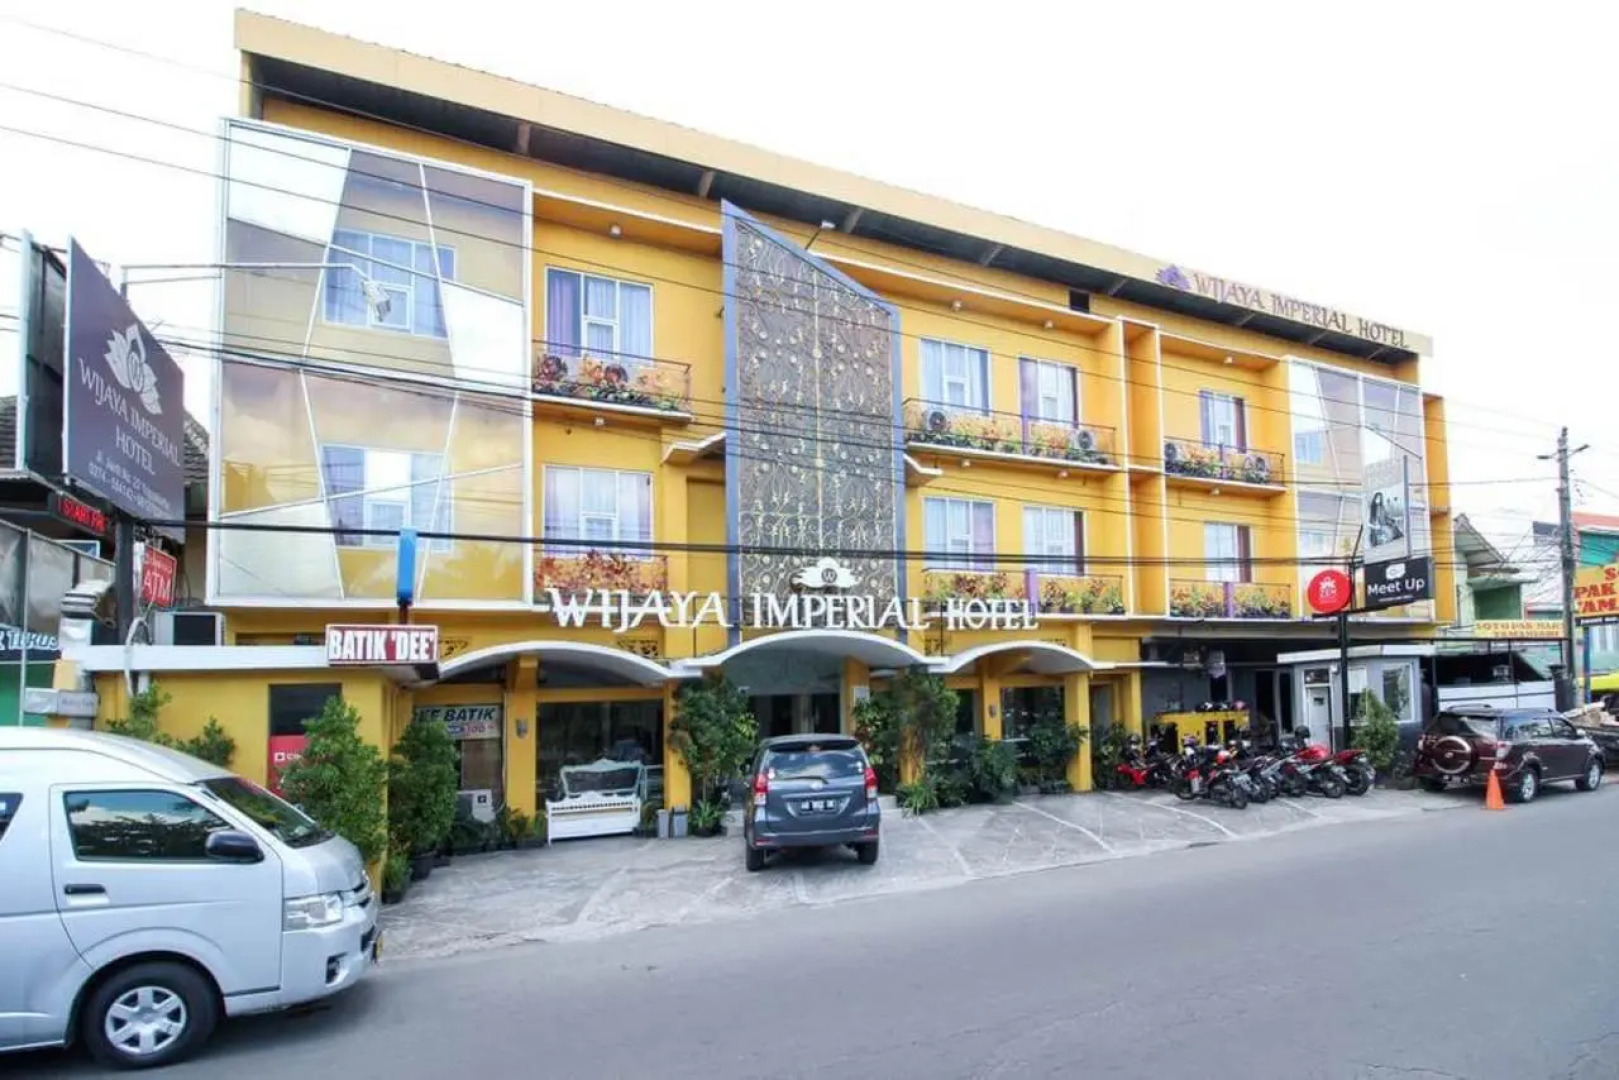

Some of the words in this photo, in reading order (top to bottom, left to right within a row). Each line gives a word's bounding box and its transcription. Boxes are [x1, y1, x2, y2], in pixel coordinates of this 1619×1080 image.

[1193, 273, 1264, 308] WIJAYA
[1270, 294, 1352, 334] IMPERIAL
[1358, 318, 1410, 349] HOTEL
[79, 356, 128, 423] WIJAYA
[129, 405, 180, 467] IMPERIAL
[116, 425, 156, 475] HOTEL
[142, 569, 173, 605] ATM
[1367, 581, 1401, 597] Meet
[1404, 578, 1425, 592] Up
[1574, 582, 1616, 599] PAK
[544, 587, 733, 632] WIJAYA
[753, 586, 930, 630] IMPERIAL
[947, 597, 1039, 631] HOTEL
[328, 629, 388, 660] BATIK
[444, 707, 495, 722] BATIK
